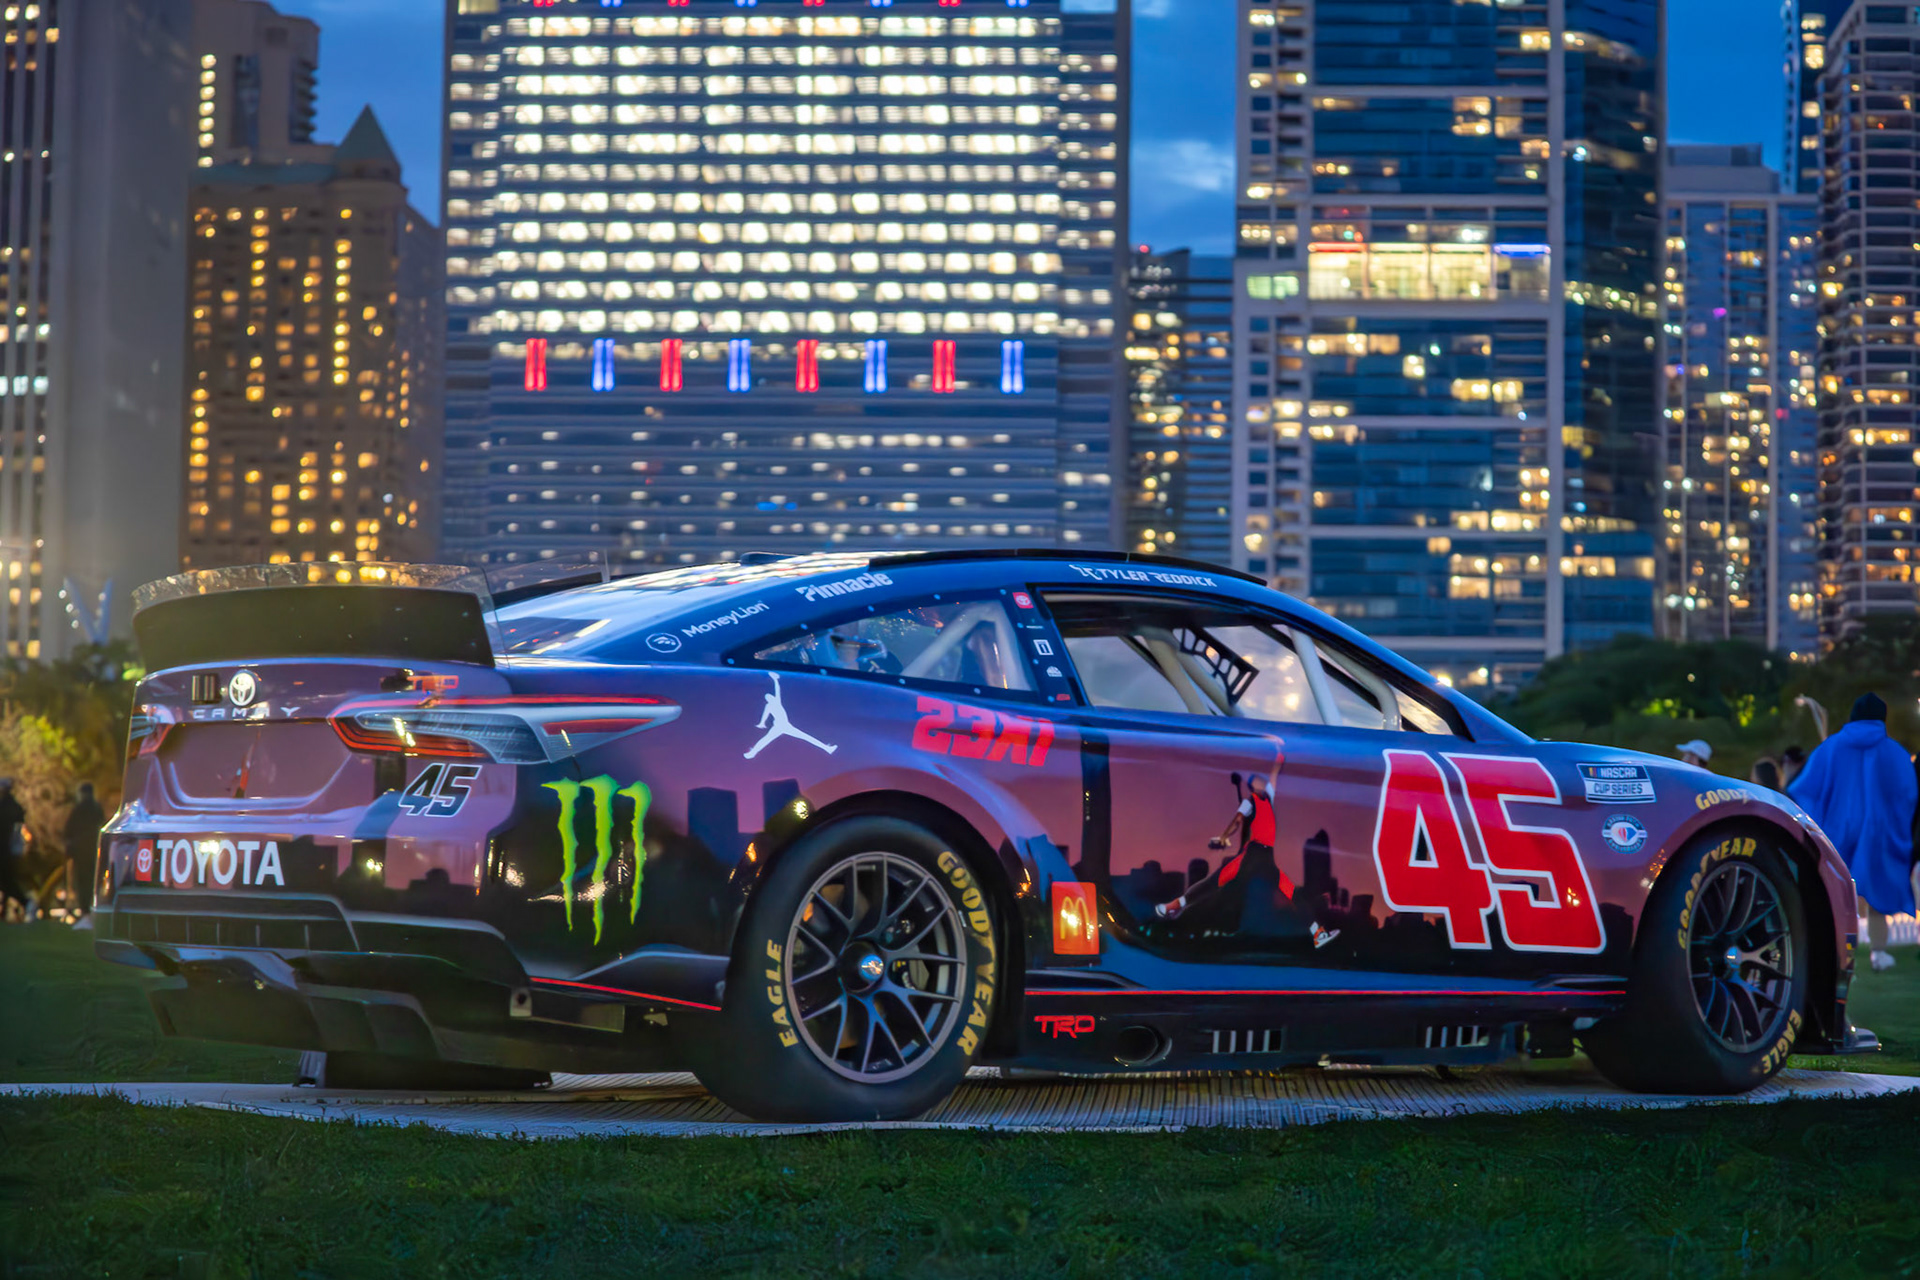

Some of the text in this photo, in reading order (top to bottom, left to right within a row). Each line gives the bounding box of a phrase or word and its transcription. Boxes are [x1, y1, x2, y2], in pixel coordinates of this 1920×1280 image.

[795, 573, 893, 602] Pinnacle
[1097, 568, 1150, 582] TYLER
[1148, 571, 1218, 588] REDDICK
[681, 600, 770, 638] MoneyLion
[398, 762, 483, 818] 45
[1594, 782, 1643, 795] CUP SERIES
[1600, 767, 1638, 778] NASCAR
[157, 838, 285, 886] TOYOTA
[1374, 749, 1606, 954] 45
[1678, 837, 1757, 949] GOODYEAR
[937, 850, 996, 1056] GOODYEAR
[766, 939, 799, 1048] EAGLE
[1034, 1015, 1096, 1039] TRD
[1761, 1008, 1803, 1075] EAGLE
